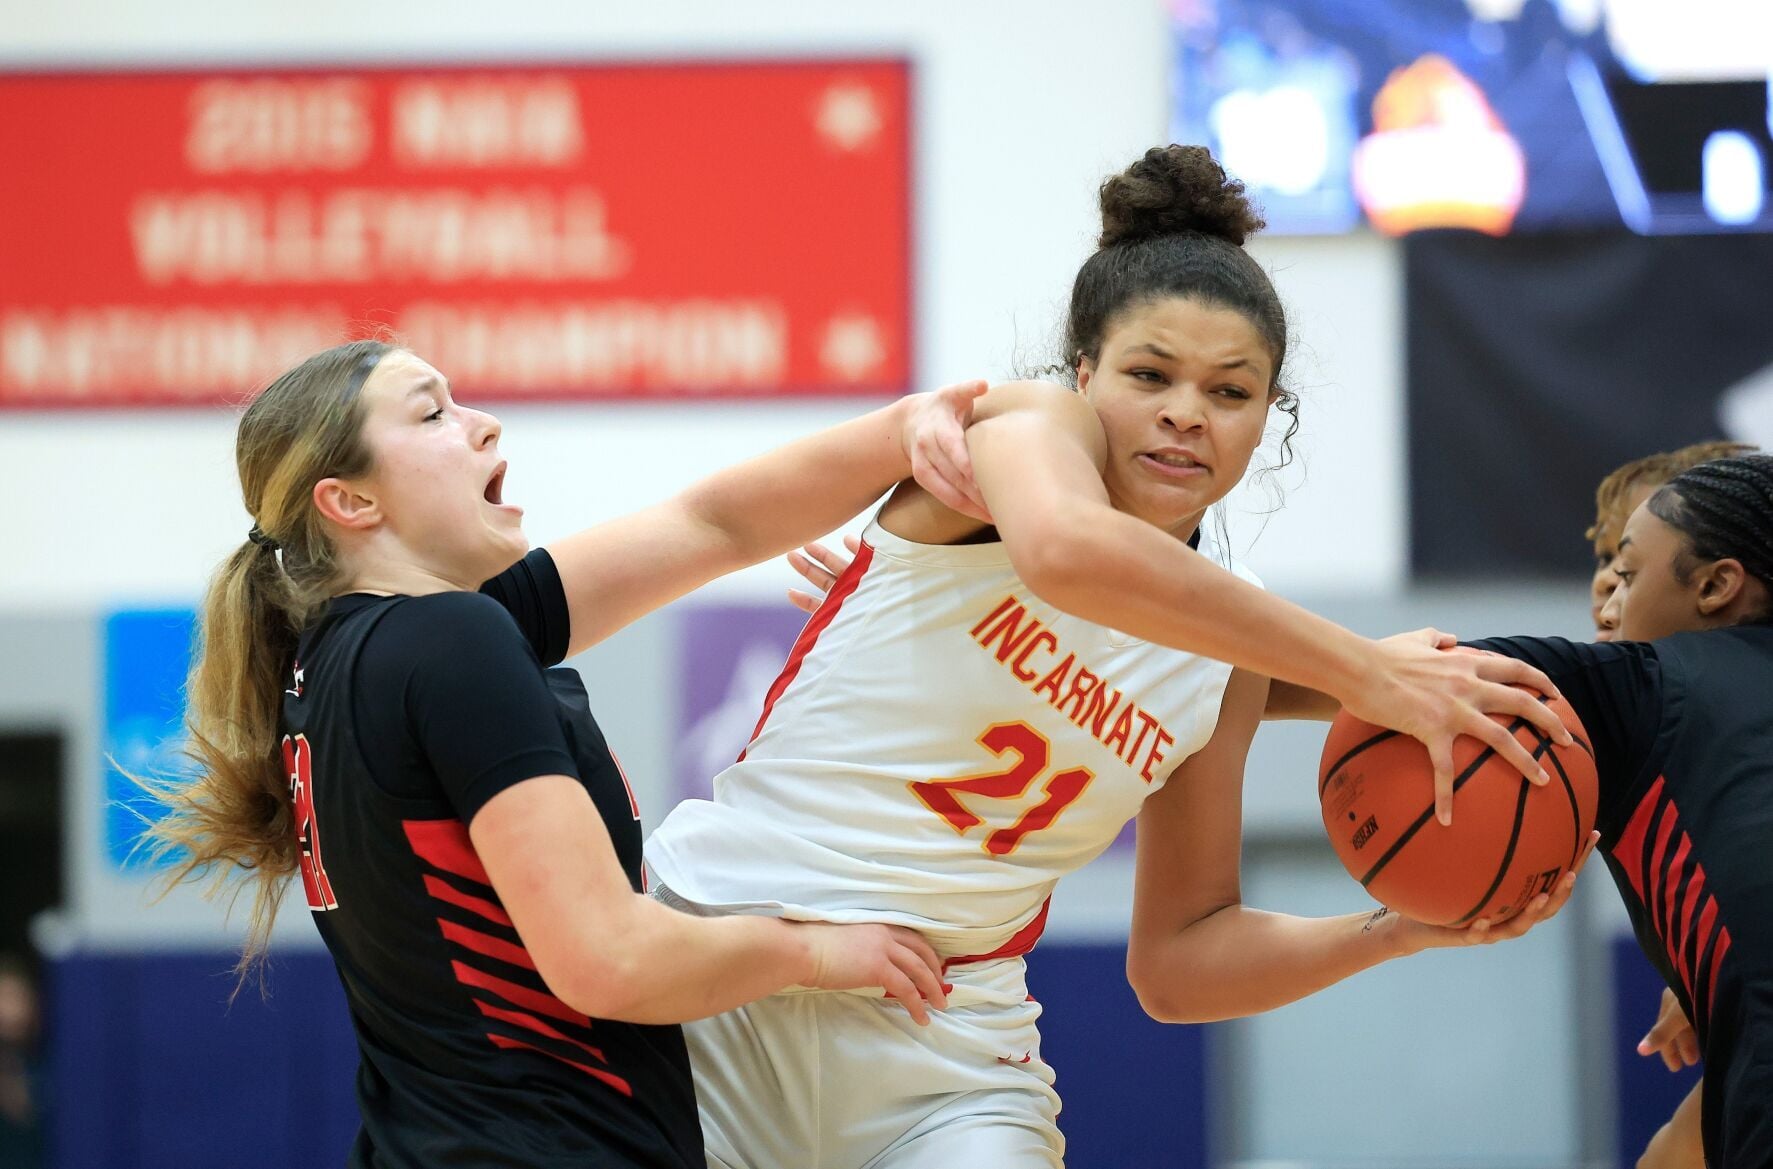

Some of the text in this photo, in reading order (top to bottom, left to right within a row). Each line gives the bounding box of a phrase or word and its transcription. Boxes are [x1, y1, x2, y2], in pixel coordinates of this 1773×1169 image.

[134, 190, 628, 283] VOLLEYBALL
[402, 302, 786, 390] CHAMPION
[968, 594, 1175, 784] INCARNATE
[906, 719, 1096, 857] 21
